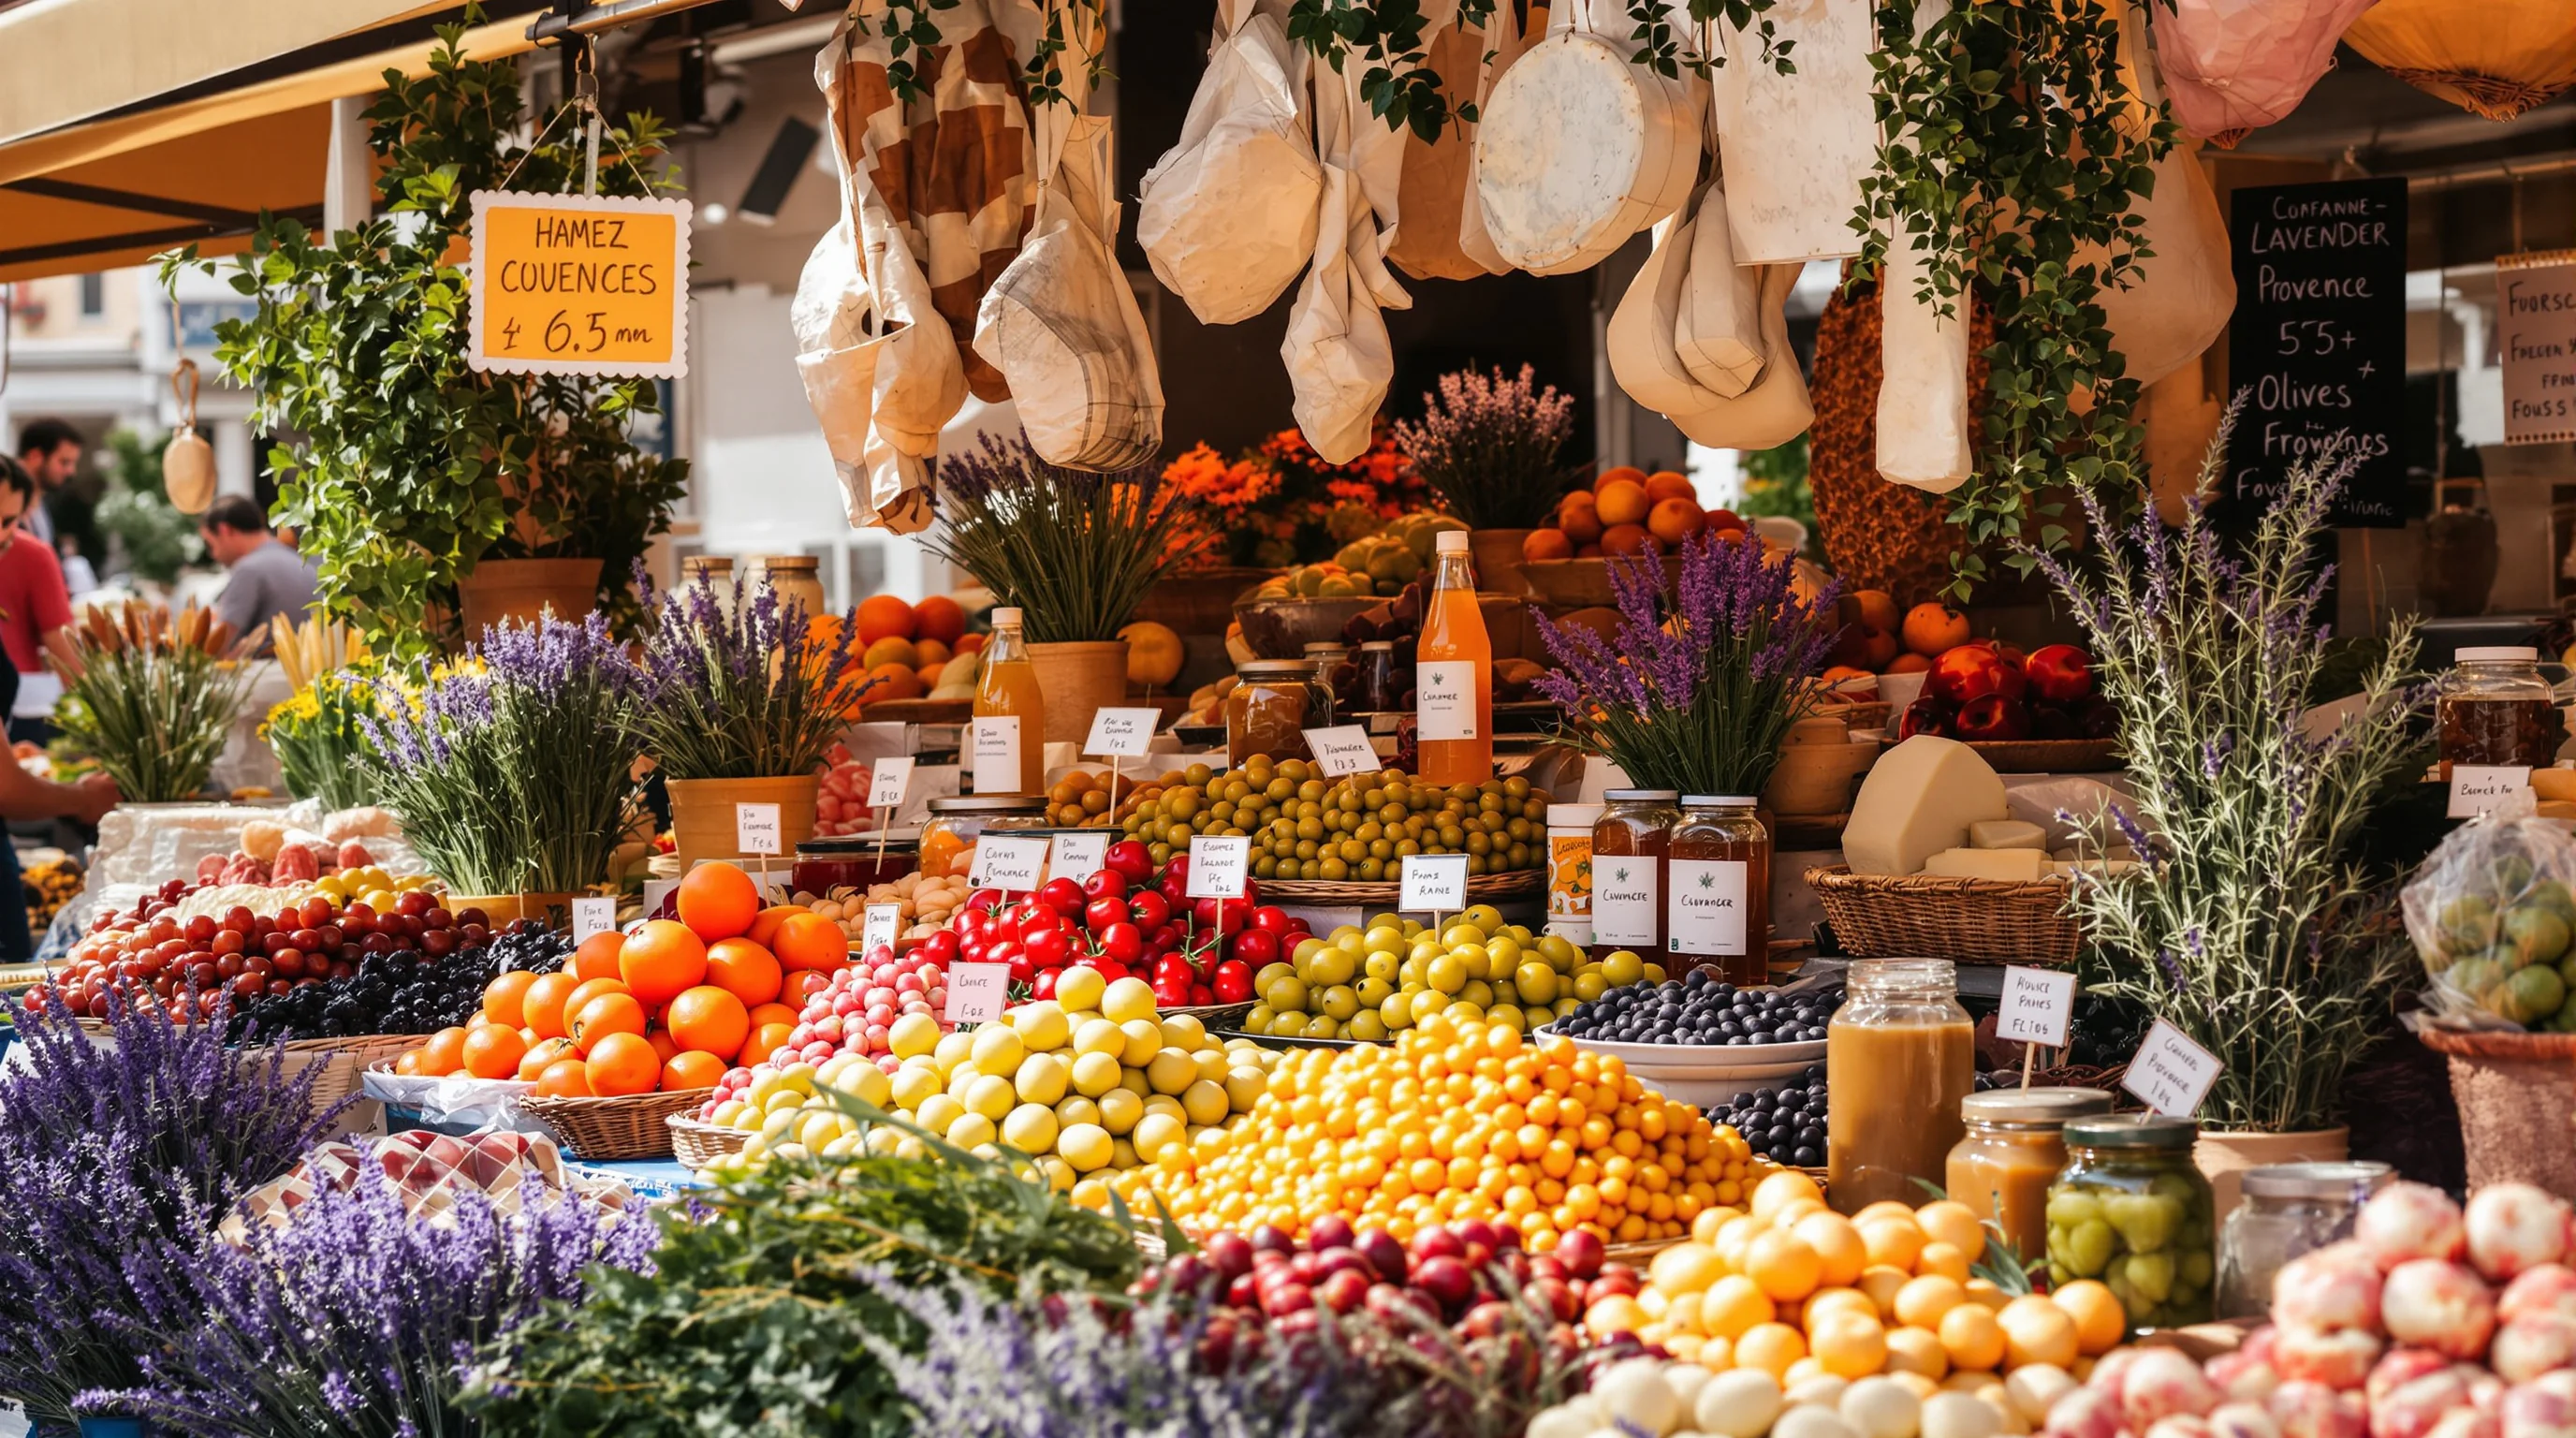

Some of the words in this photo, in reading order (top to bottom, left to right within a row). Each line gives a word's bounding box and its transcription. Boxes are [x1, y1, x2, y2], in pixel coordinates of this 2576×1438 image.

[535, 215, 629, 250] HAMEZ
[2250, 221, 2391, 255] LAVENDER
[2259, 263, 2375, 304] Provence
[543, 309, 607, 354] 6.5
[2258, 370, 2352, 411] Olives
